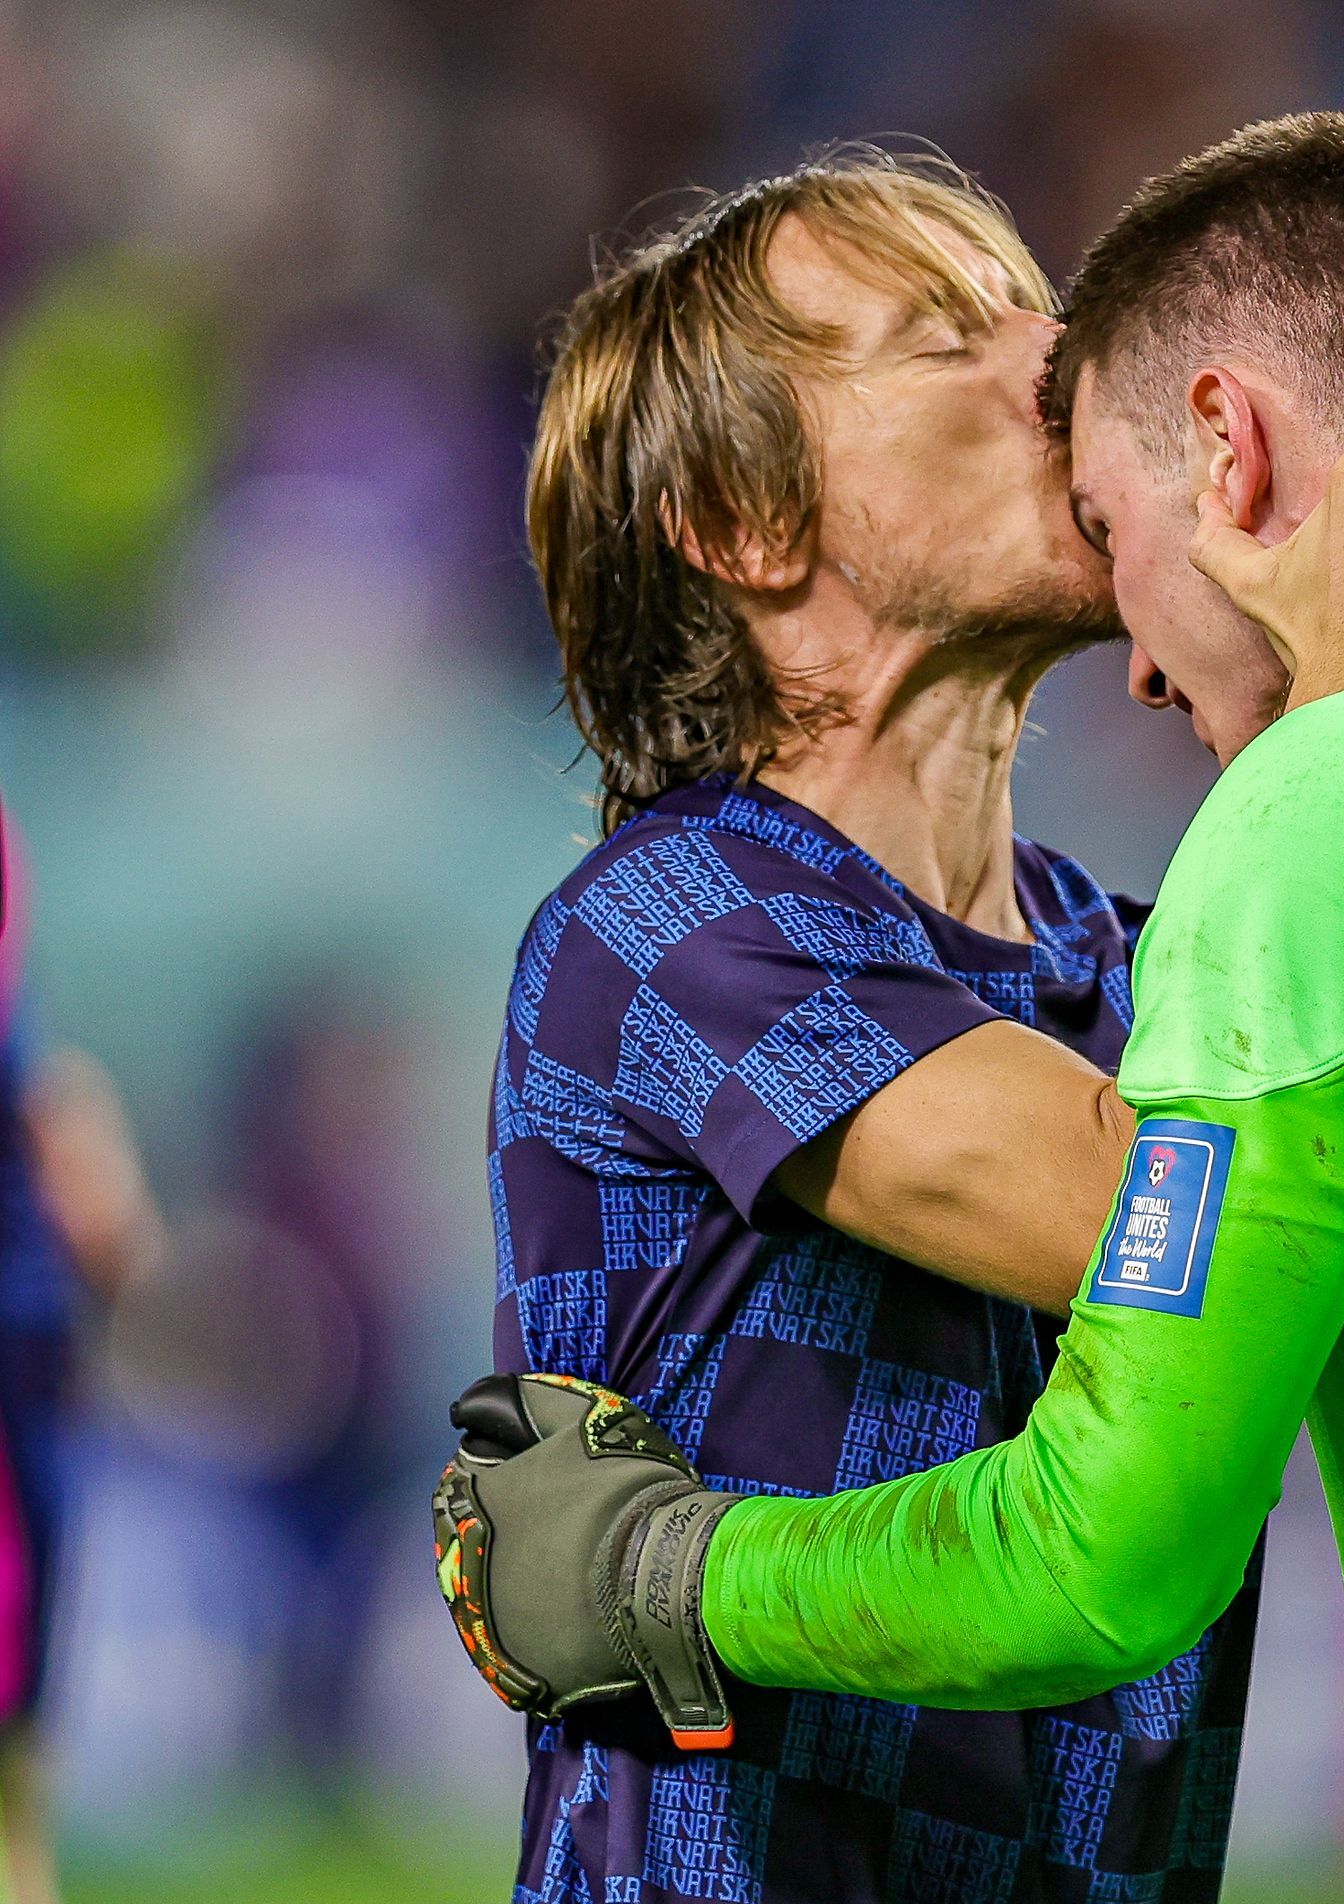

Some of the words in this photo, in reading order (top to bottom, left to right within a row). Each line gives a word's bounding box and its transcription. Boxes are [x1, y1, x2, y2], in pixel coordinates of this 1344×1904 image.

[571, 831, 711, 919] HRVATSKA
[582, 842, 720, 932] HRVATSKA
[596, 857, 731, 947] HRVATSKA
[611, 872, 744, 965] HRVATSKA
[628, 887, 758, 981] HRVATSKA
[733, 985, 853, 1086] HRVATSKA
[750, 1003, 871, 1104] HRVATSKA
[783, 1037, 910, 1138] HRVATSKA
[1118, 1238, 1133, 1257] the
[1130, 1239, 1169, 1263] World
[1125, 1213, 1169, 1240] UNITES
[1130, 1195, 1171, 1217] FOOTBALL
[1124, 1263, 1143, 1277] FIFA
[851, 1385, 978, 1447] HRVATSKA
